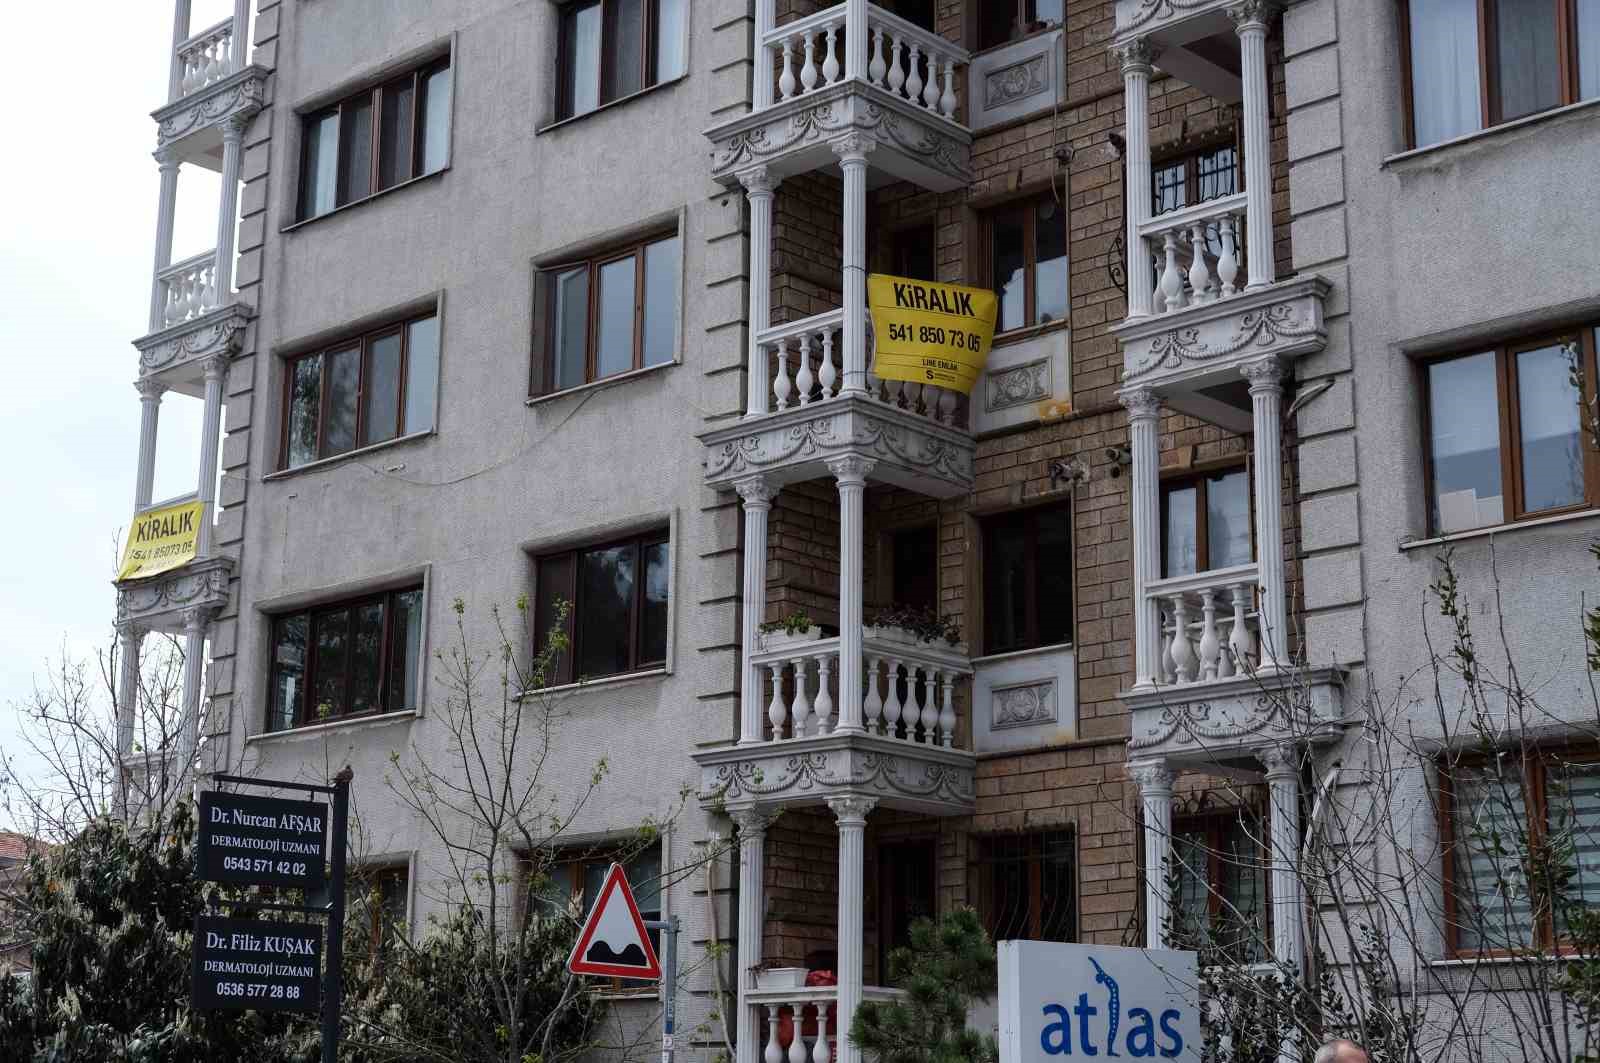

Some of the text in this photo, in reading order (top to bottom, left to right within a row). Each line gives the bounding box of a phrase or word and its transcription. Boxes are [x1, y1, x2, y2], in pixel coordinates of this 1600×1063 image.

[889, 324, 981, 352] 541 850 73 05
[211, 806, 322, 835] Dr. Nurcan AFŞAR
[281, 841, 320, 855] UZMANI
[223, 856, 306, 876] 0543 571 42 02
[206, 932, 315, 958] Dr. Filiz KUŞAK
[275, 965, 314, 977] UZMANI
[216, 982, 300, 999] 0536 577 28 88
